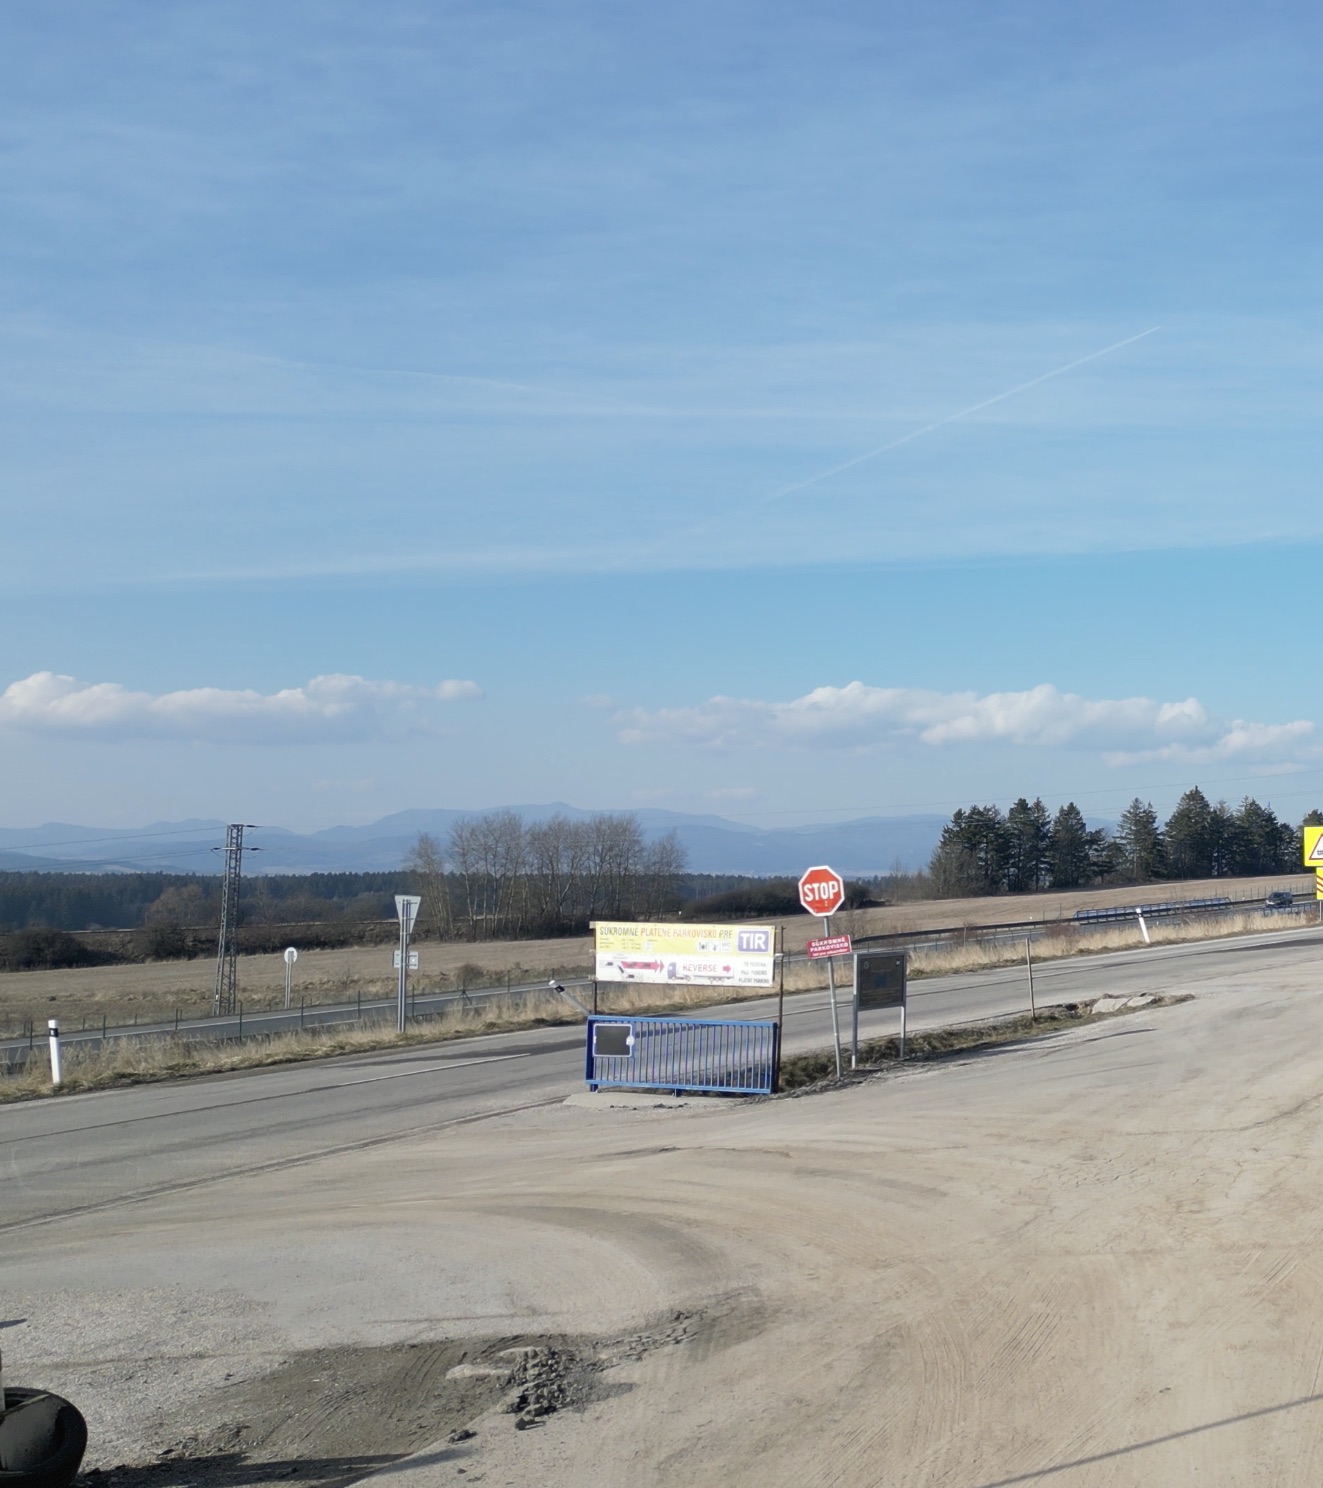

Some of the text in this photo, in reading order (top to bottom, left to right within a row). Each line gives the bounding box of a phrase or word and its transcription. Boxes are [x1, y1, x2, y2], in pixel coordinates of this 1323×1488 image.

[803, 881, 839, 902] STOP
[718, 929, 733, 938] PRE
[740, 933, 766, 950] TIR
[682, 963, 717, 973] REVERSE
